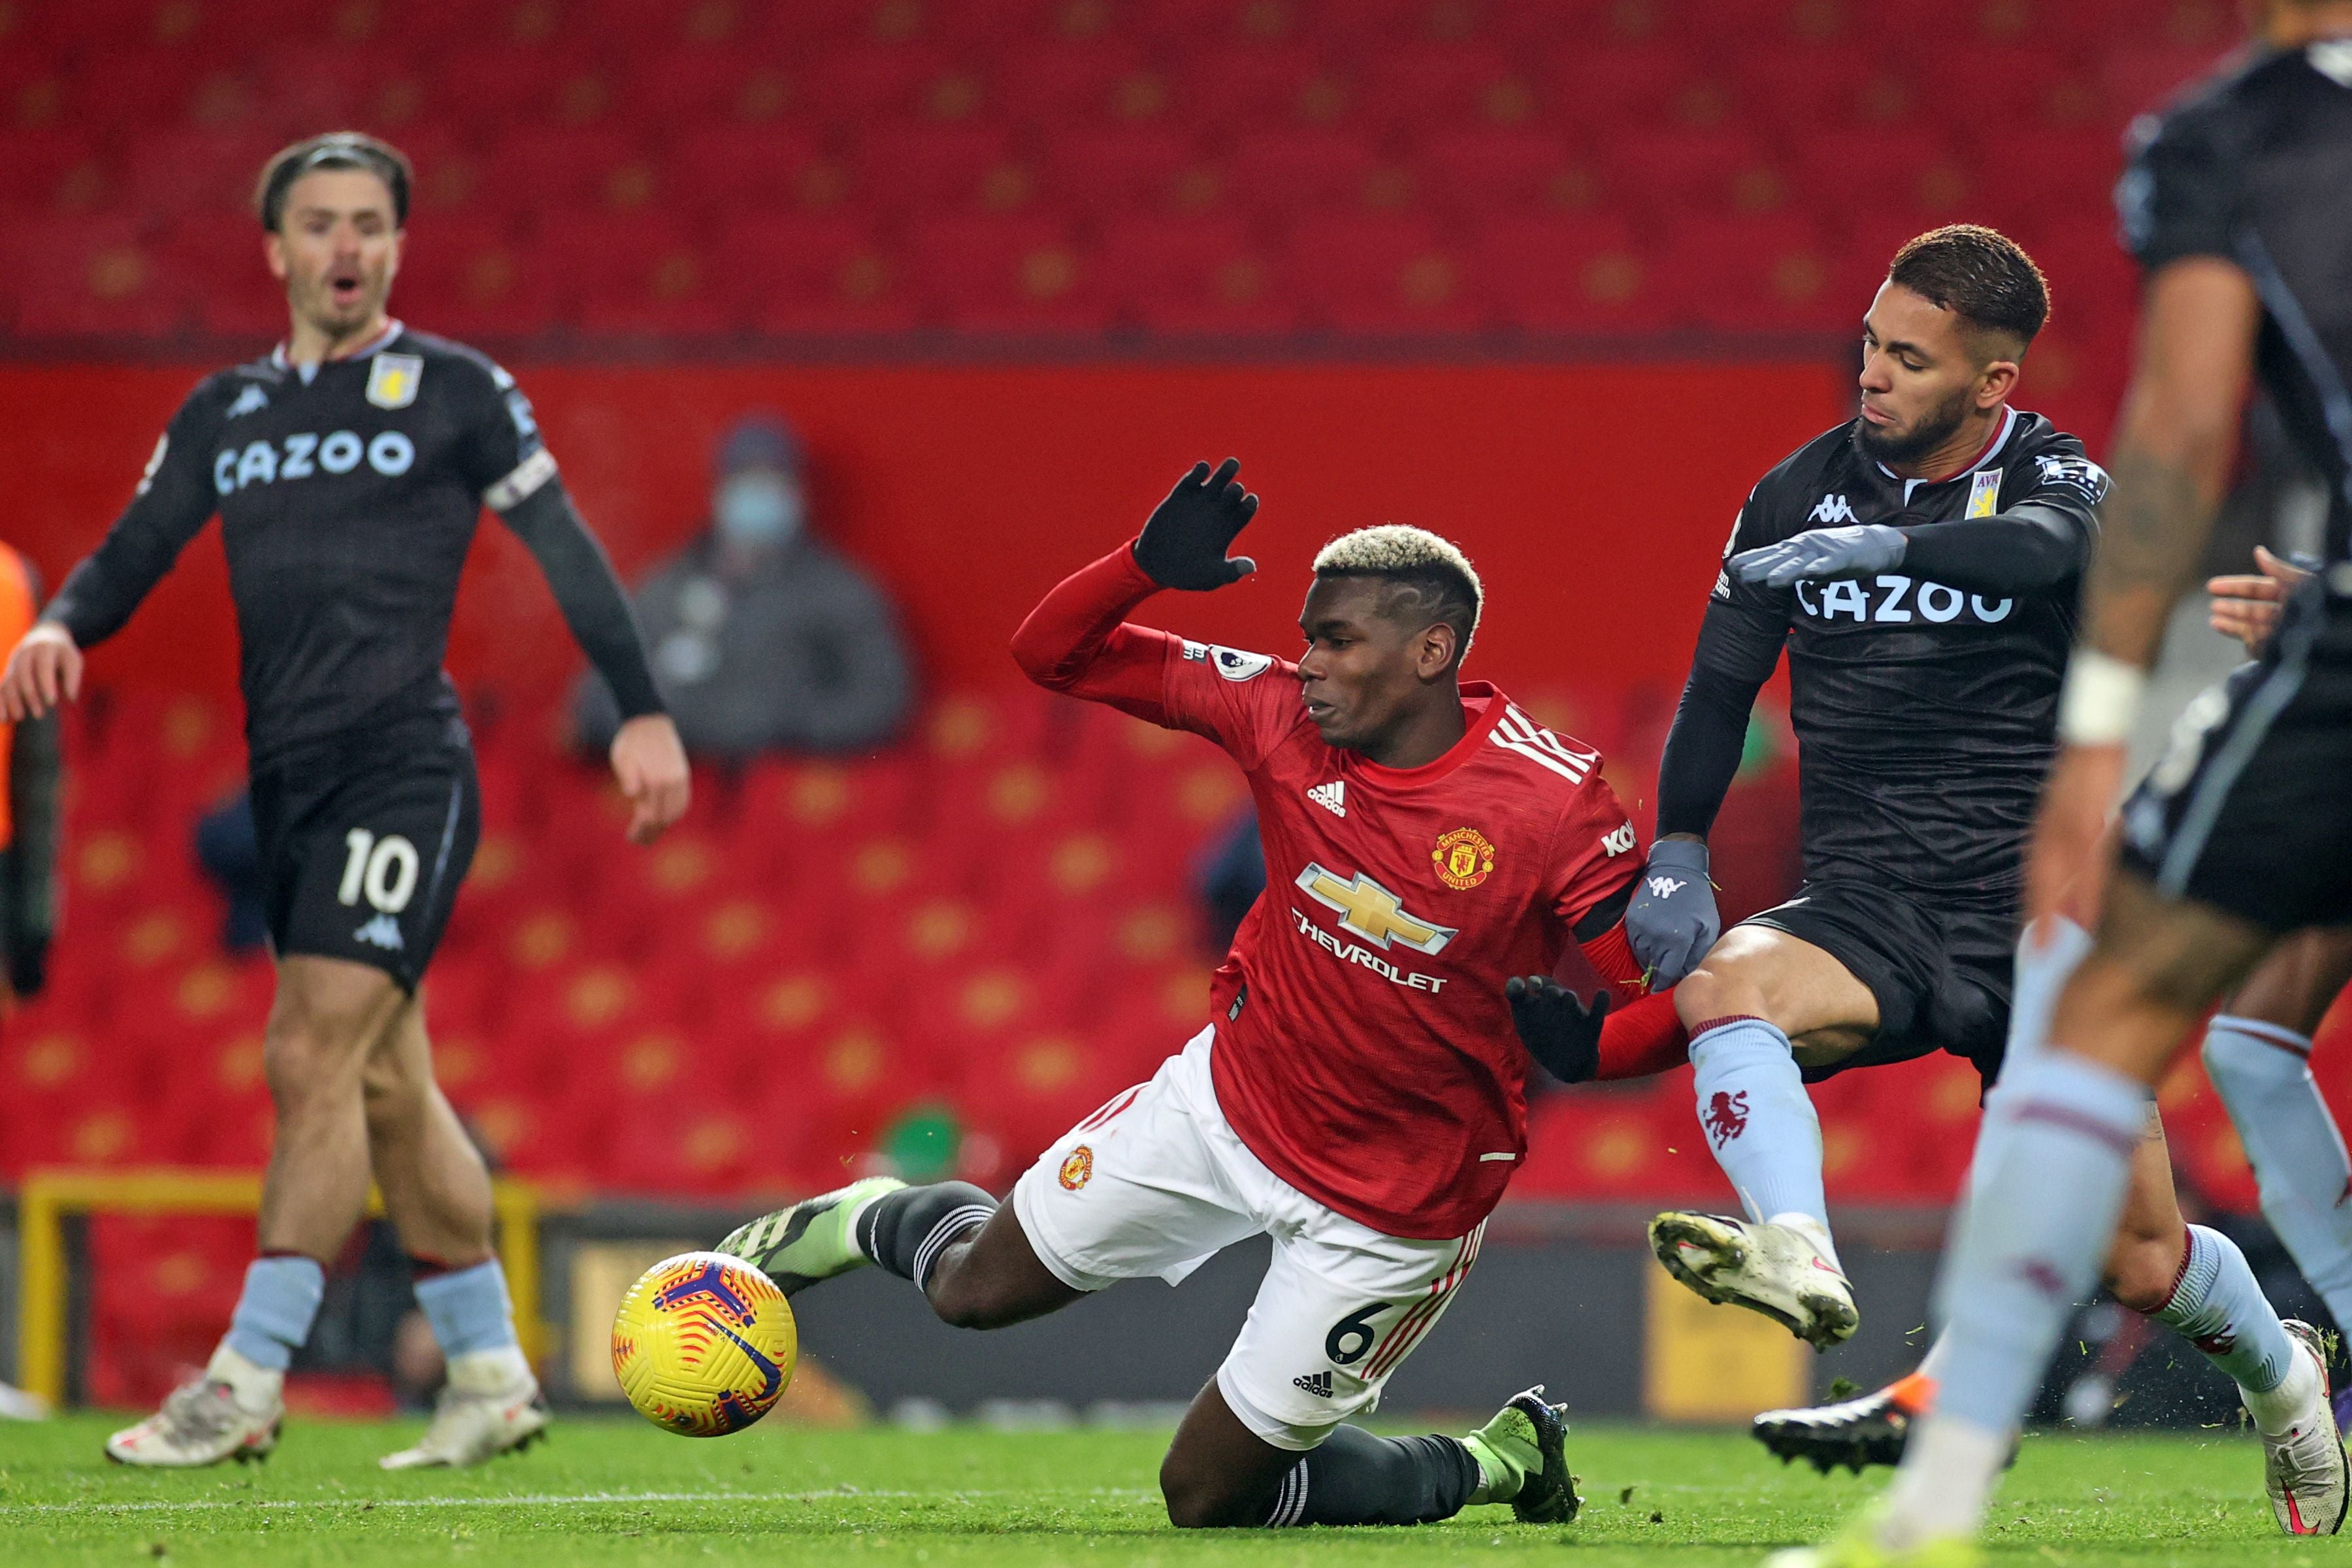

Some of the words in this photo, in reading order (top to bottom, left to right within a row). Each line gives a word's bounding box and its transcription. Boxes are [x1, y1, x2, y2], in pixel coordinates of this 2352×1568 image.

[213, 429, 416, 497] CAZOO
[1307, 788, 1347, 818] adidas
[1441, 832, 1490, 857] MANCHESTER
[337, 826, 419, 914] 10
[1442, 871, 1477, 887] UNITED
[1290, 906, 1448, 994] CHEVROLET
[1325, 1302, 1394, 1365] 6
[1293, 1377, 1334, 1398] adidas
